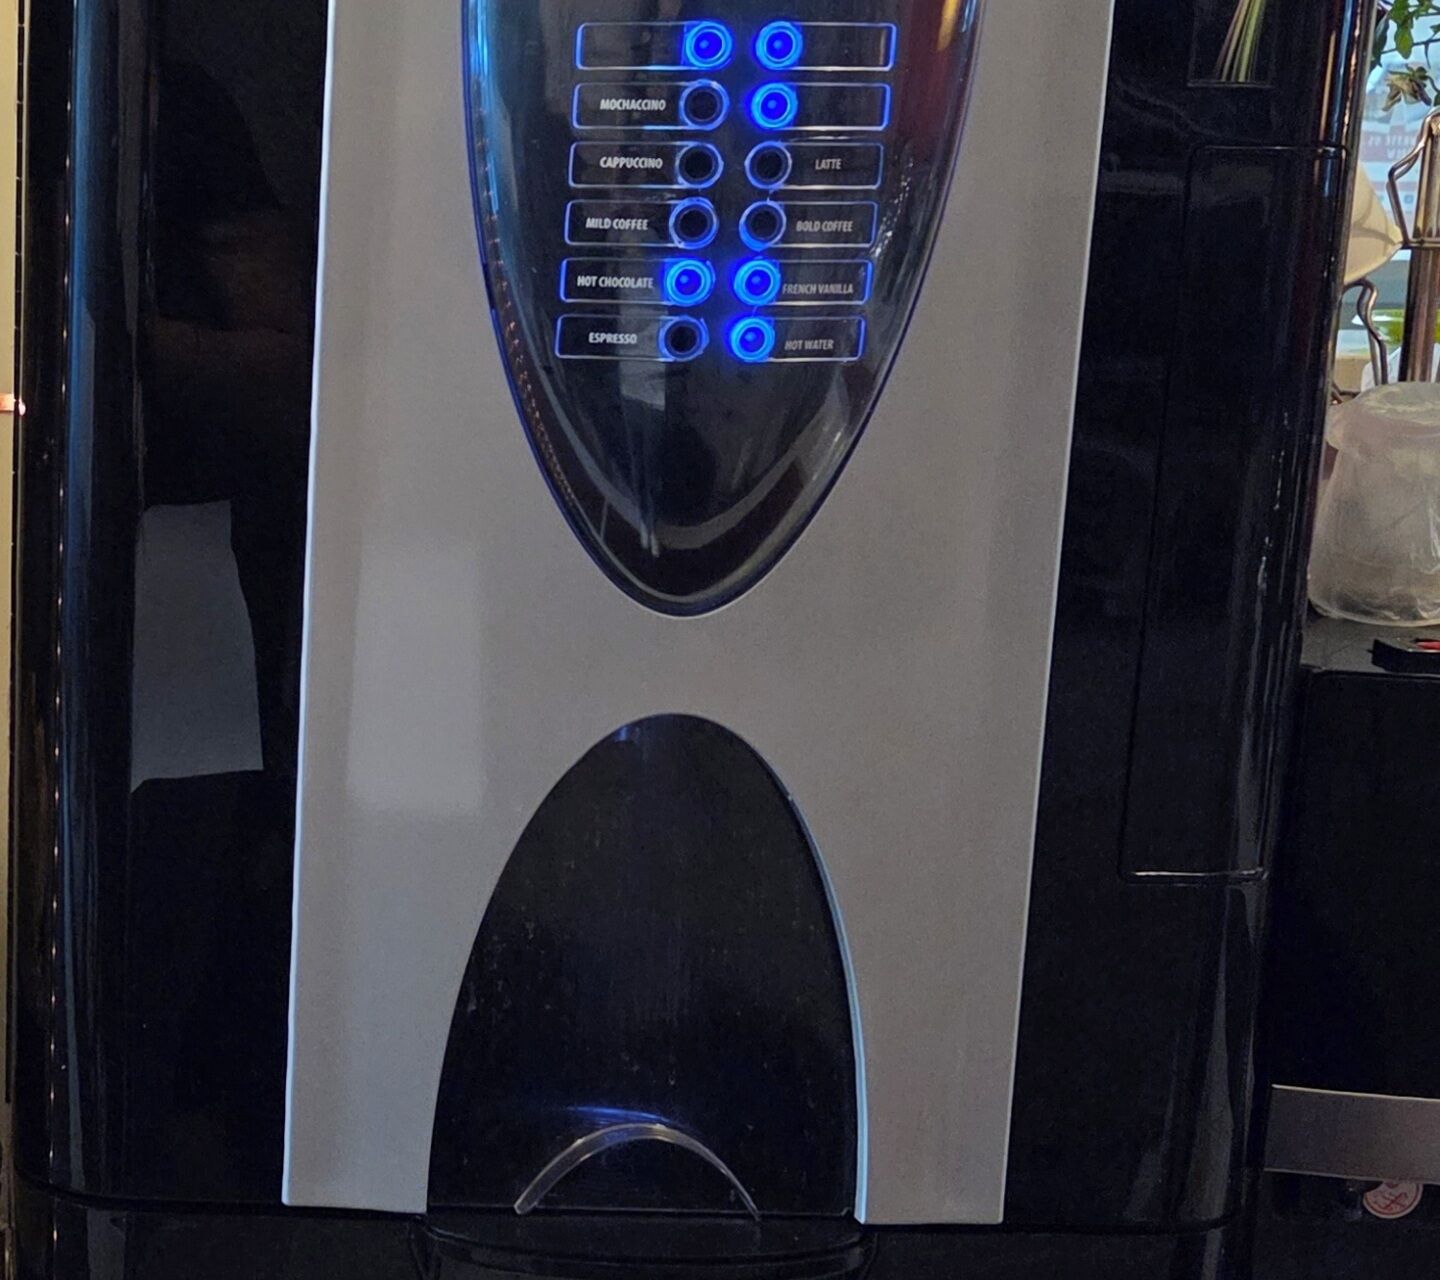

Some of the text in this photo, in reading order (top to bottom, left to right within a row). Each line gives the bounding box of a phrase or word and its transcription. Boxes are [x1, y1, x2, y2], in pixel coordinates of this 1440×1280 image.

[600, 98, 667, 111] MOCHACCINO
[599, 156, 663, 169] CAPPUCCINO
[815, 158, 842, 170] LATTE
[586, 216, 649, 230] MILD COFFEE
[796, 220, 853, 233] BOLD COFFEE
[577, 275, 654, 289] HOT CHOCOLATE
[782, 282, 854, 295] FRENCH VANILLA
[588, 332, 638, 345] ESPRESSO
[784, 338, 834, 351] HOT WATER
